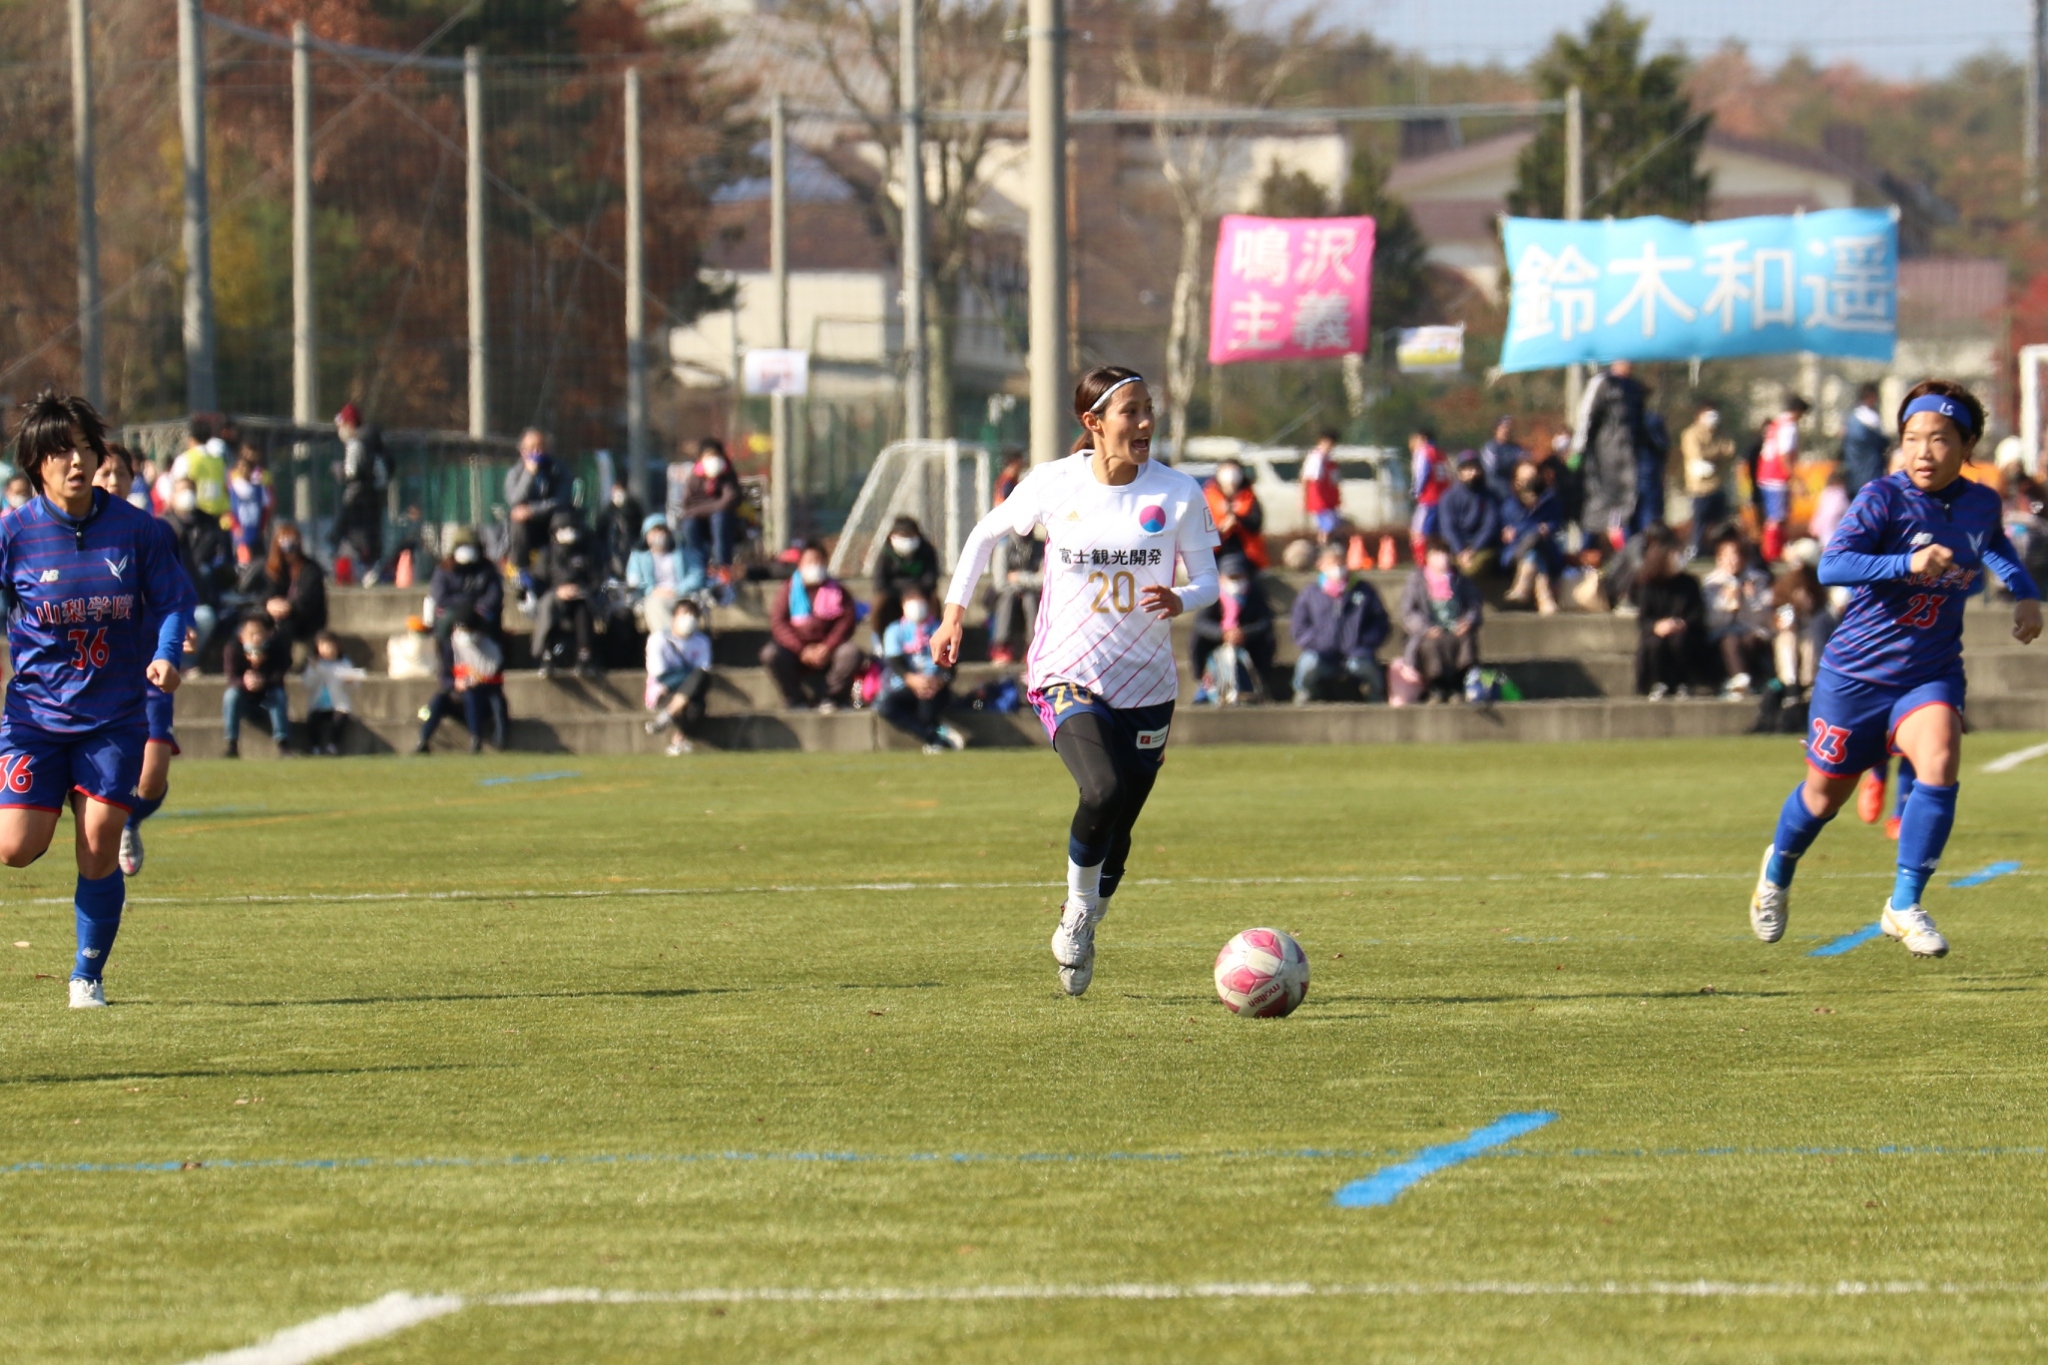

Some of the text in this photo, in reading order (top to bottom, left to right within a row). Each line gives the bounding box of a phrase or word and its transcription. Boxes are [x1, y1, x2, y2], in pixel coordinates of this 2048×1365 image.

[1233, 227, 1356, 286] 鳴沢
[1513, 234, 1895, 342] 鈴木和遥
[1228, 290, 1351, 352] 主義
[1059, 548, 1163, 566] 富士観光開発
[35, 595, 134, 625] 山梨学院
[1088, 571, 1135, 613] 20
[1896, 593, 1948, 629] 23
[68, 627, 110, 670] 36
[1810, 717, 1852, 764] 23
[1247, 983, 1281, 1007] molten
